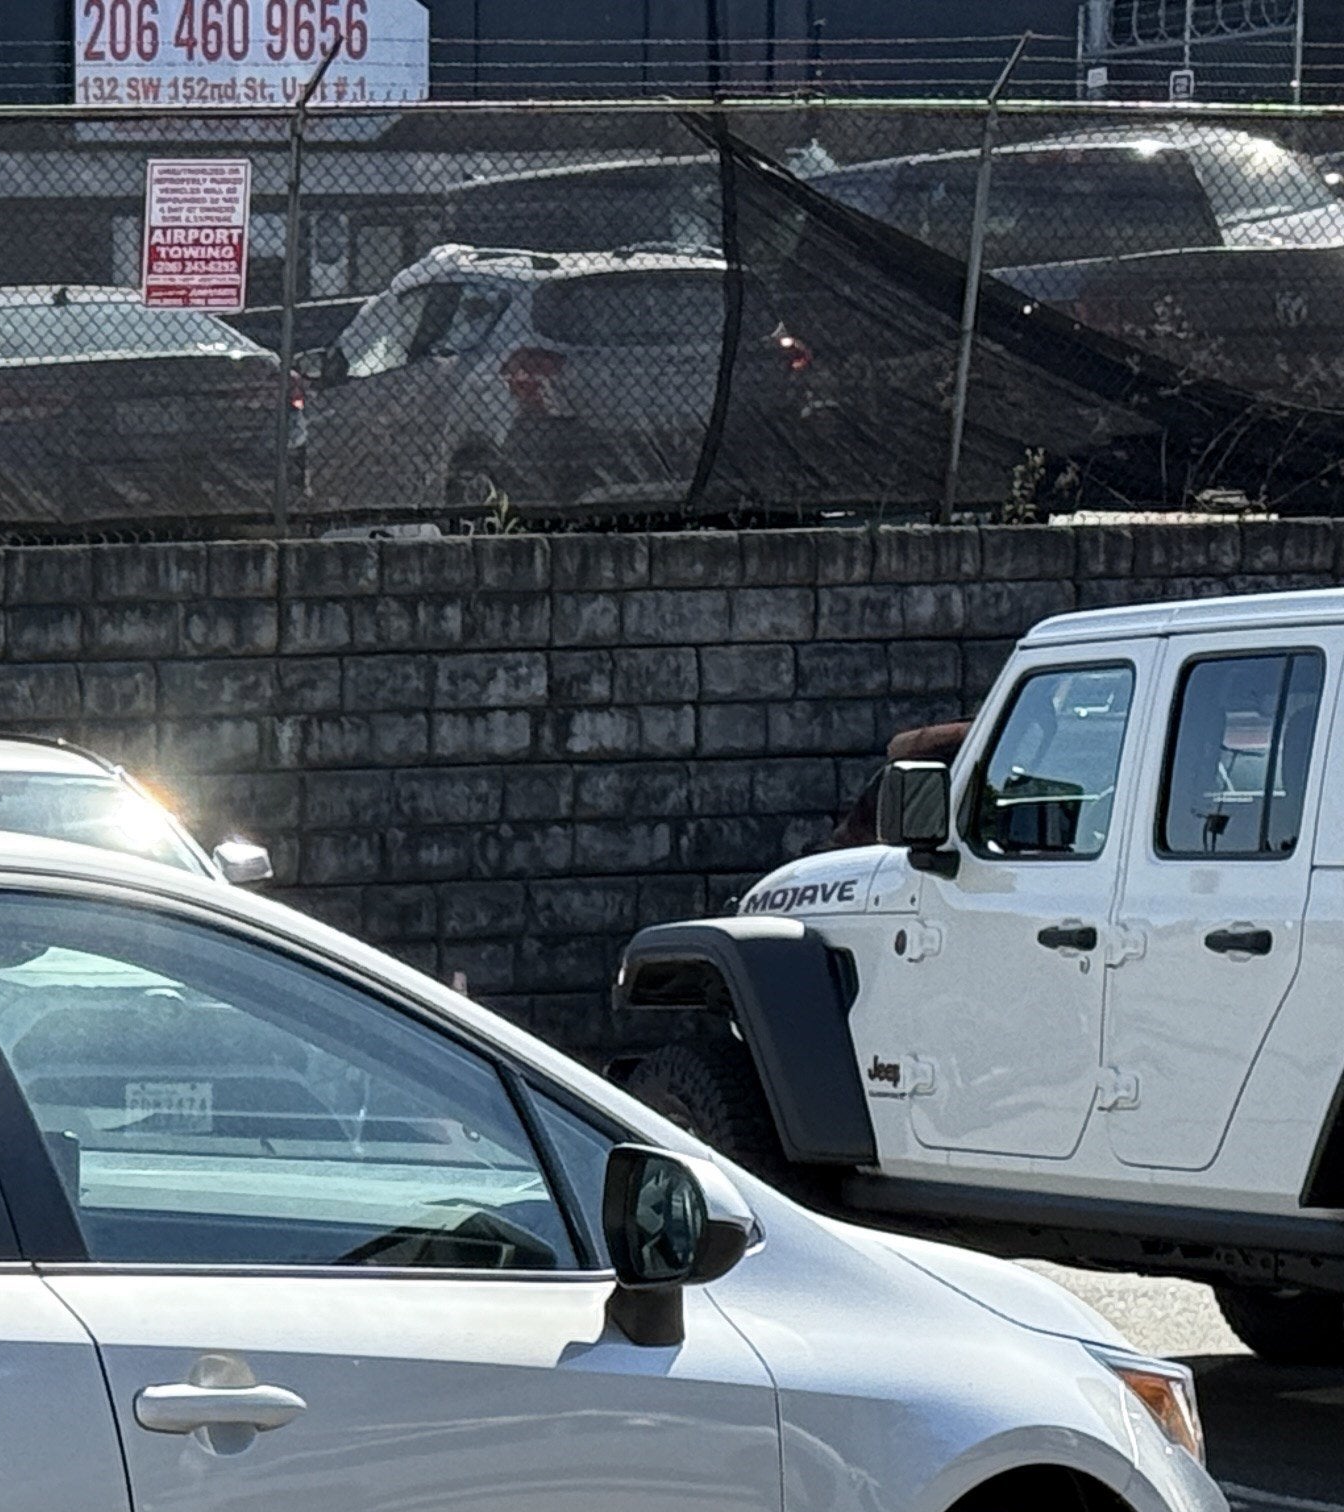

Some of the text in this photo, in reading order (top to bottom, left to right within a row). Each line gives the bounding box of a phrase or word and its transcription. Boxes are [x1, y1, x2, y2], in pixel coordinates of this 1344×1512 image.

[83, 0, 368, 61] 206 460 9656
[78, 76, 120, 101] 132
[126, 76, 162, 102] SW
[168, 76, 237, 102] 152nd
[281, 76, 328, 102] Unt
[151, 228, 243, 245] AIRPORT
[156, 245, 235, 260] TOWING
[743, 879, 859, 913] MOJAVE
[867, 1054, 901, 1088] Jeep
